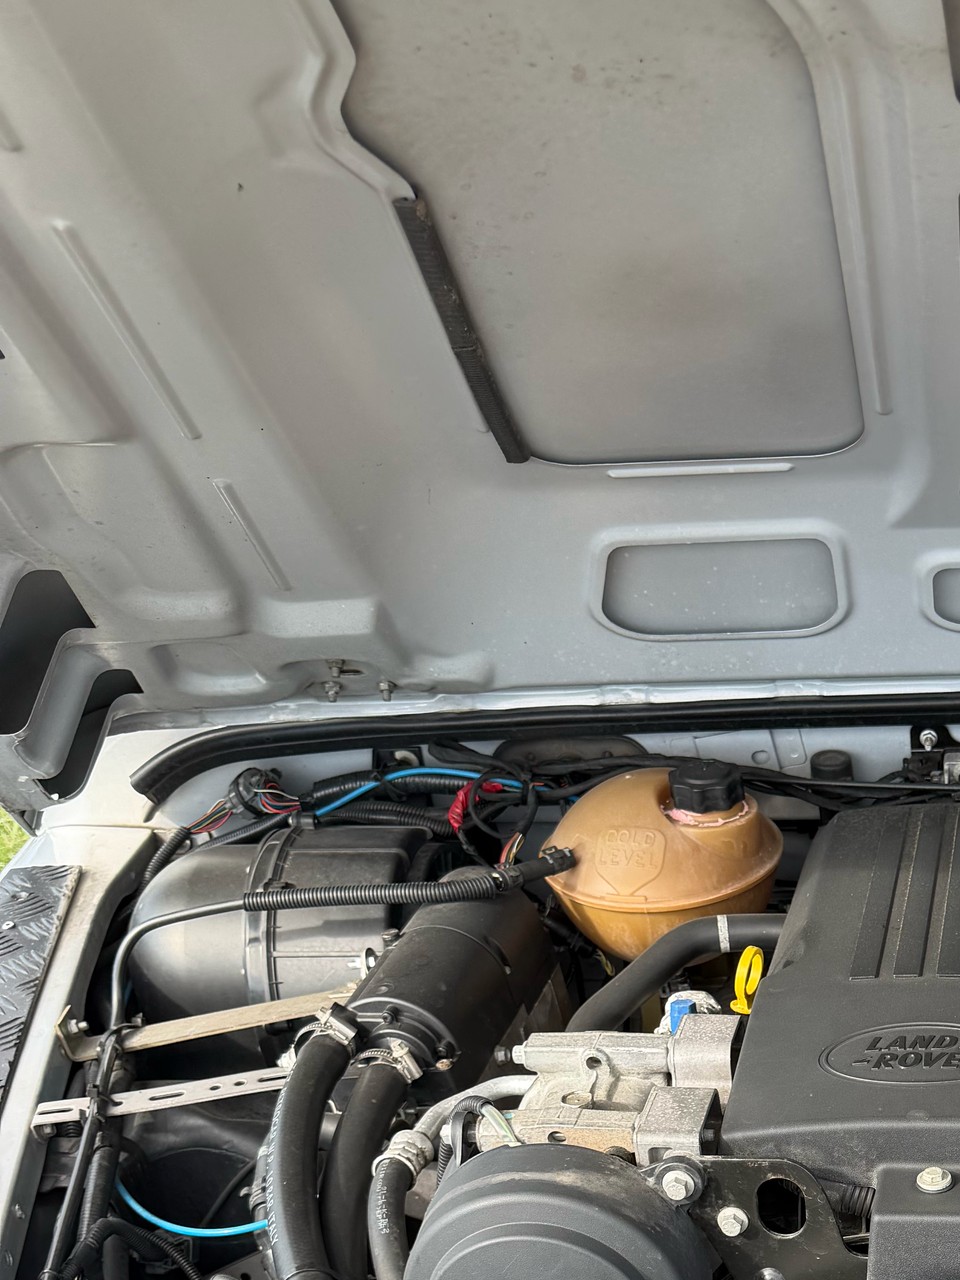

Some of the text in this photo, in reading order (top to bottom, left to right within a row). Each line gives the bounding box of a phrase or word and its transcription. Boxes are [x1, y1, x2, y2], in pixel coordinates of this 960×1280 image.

[607, 829, 656, 847] COLD
[600, 848, 658, 870] LEVEL
[865, 1034, 959, 1053] LAND
